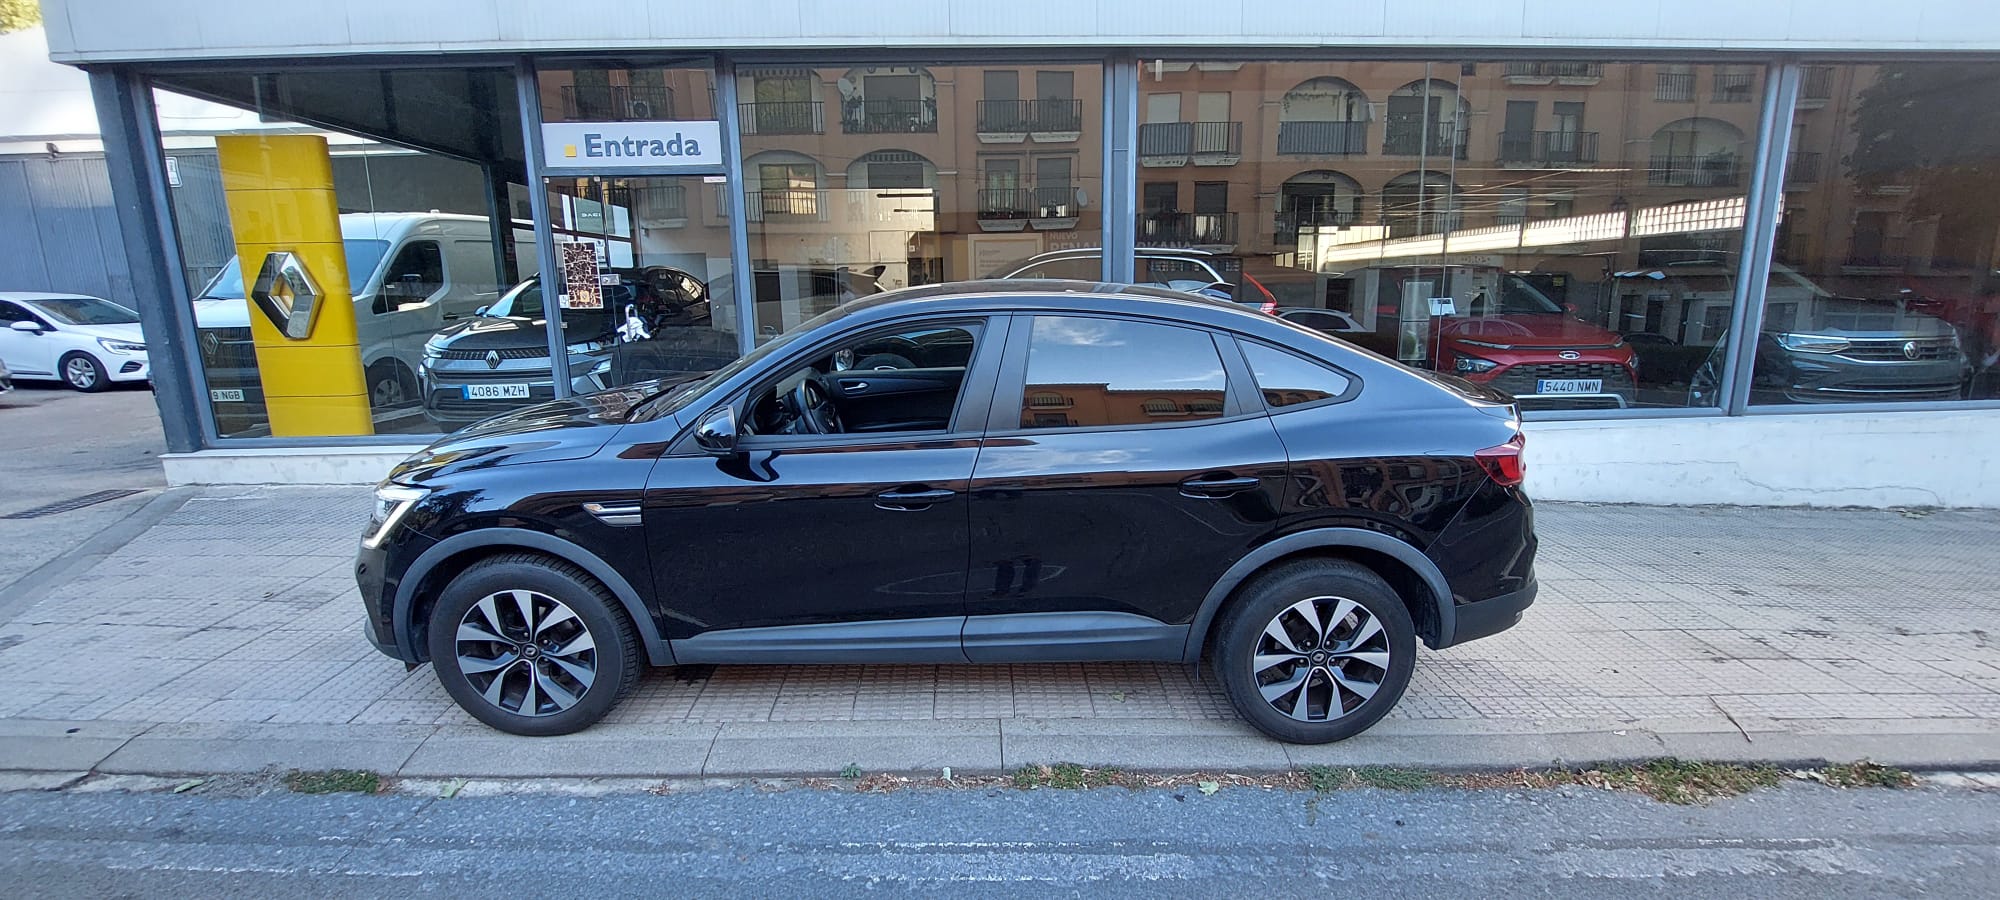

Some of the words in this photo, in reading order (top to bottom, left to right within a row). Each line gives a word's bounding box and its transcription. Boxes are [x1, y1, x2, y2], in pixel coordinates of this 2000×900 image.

[584, 132, 701, 158] Entrada
[1049, 231, 1079, 241] NUEVO
[471, 386, 500, 397] 4086
[503, 385, 526, 397] MZH
[1545, 381, 1574, 392] 5440
[1577, 381, 1599, 392] NMN
[212, 391, 219, 400] 9
[221, 391, 240, 400] NGB
